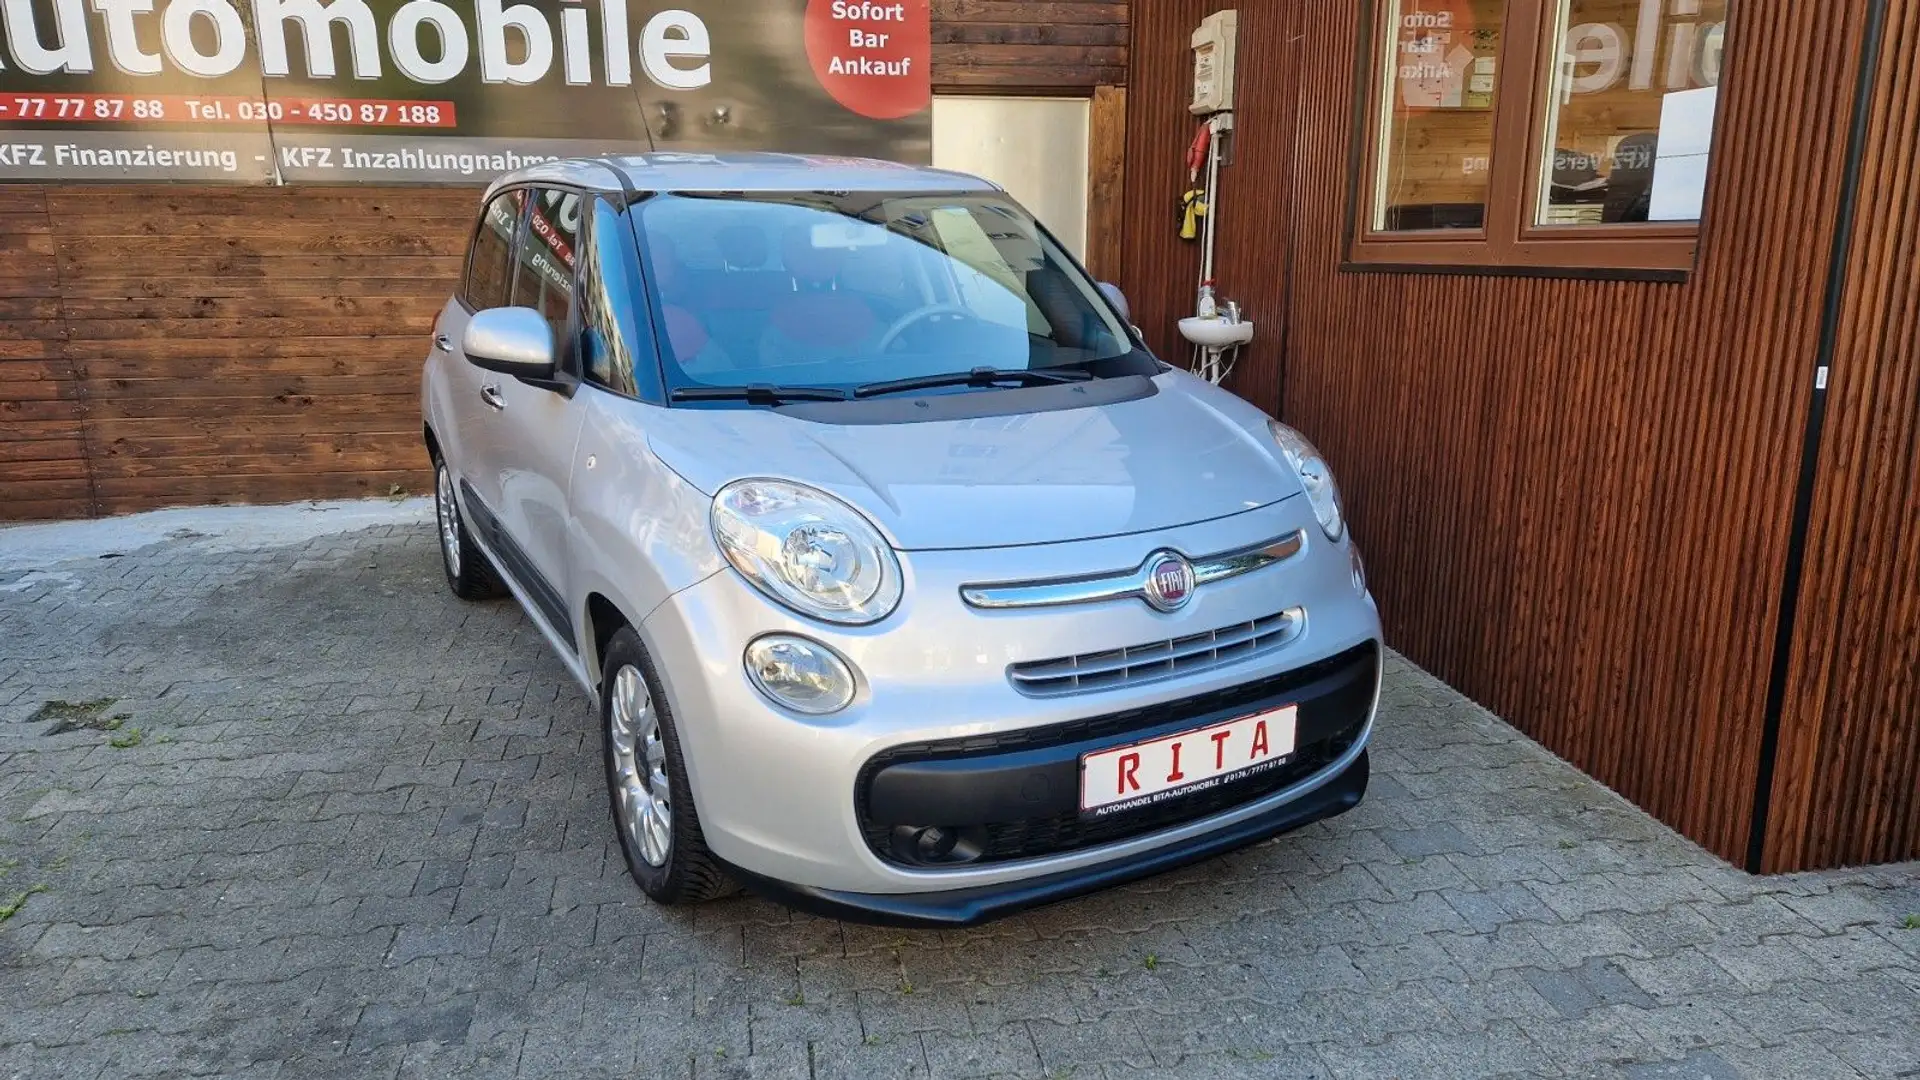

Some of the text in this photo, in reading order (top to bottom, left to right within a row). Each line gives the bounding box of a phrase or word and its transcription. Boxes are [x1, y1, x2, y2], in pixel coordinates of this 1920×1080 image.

[832, 1, 904, 21] Sofort
[0, 0, 711, 90] utomobile
[849, 29, 889, 48] Bar
[828, 56, 911, 76] Ankauf
[14, 98, 46, 117] 77
[54, 98, 85, 117] 77
[94, 98, 124, 118] 87
[133, 99, 164, 118] 88
[185, 100, 231, 119] Tel.
[238, 102, 282, 120] 030
[308, 103, 353, 121] 450
[360, 104, 388, 123] 87
[398, 105, 440, 124] 188
[0, 144, 47, 166] KFZ
[54, 143, 237, 172] Finanzierung
[282, 147, 334, 168] KFZ
[1160, 569, 1184, 593] FIAT
[1095, 796, 1152, 817] AUTOHANDEL
